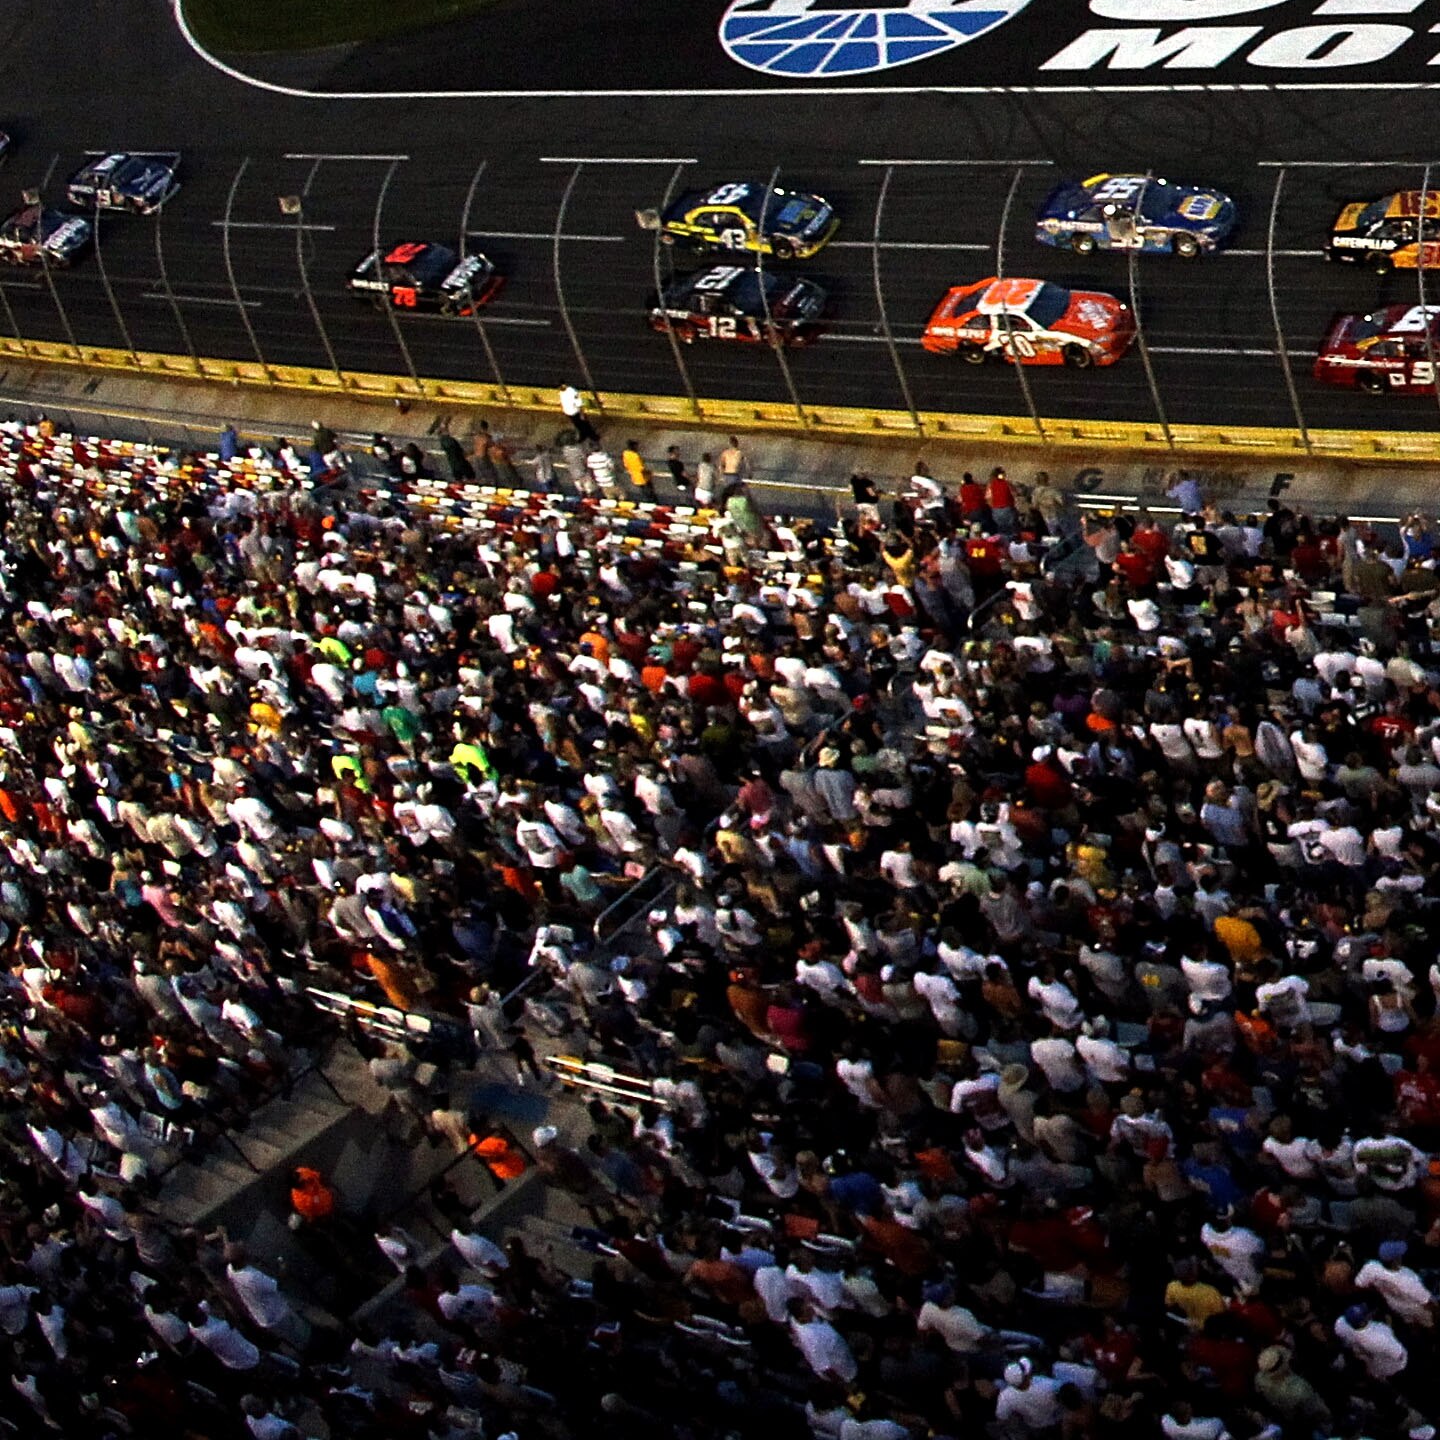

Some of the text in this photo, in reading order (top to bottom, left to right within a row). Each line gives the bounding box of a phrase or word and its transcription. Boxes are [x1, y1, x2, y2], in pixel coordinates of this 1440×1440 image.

[1333, 236, 1398, 251] CATERPILLAR
[708, 316, 738, 338] 12
[1073, 467, 1104, 492] G
[1268, 473, 1296, 496] F
